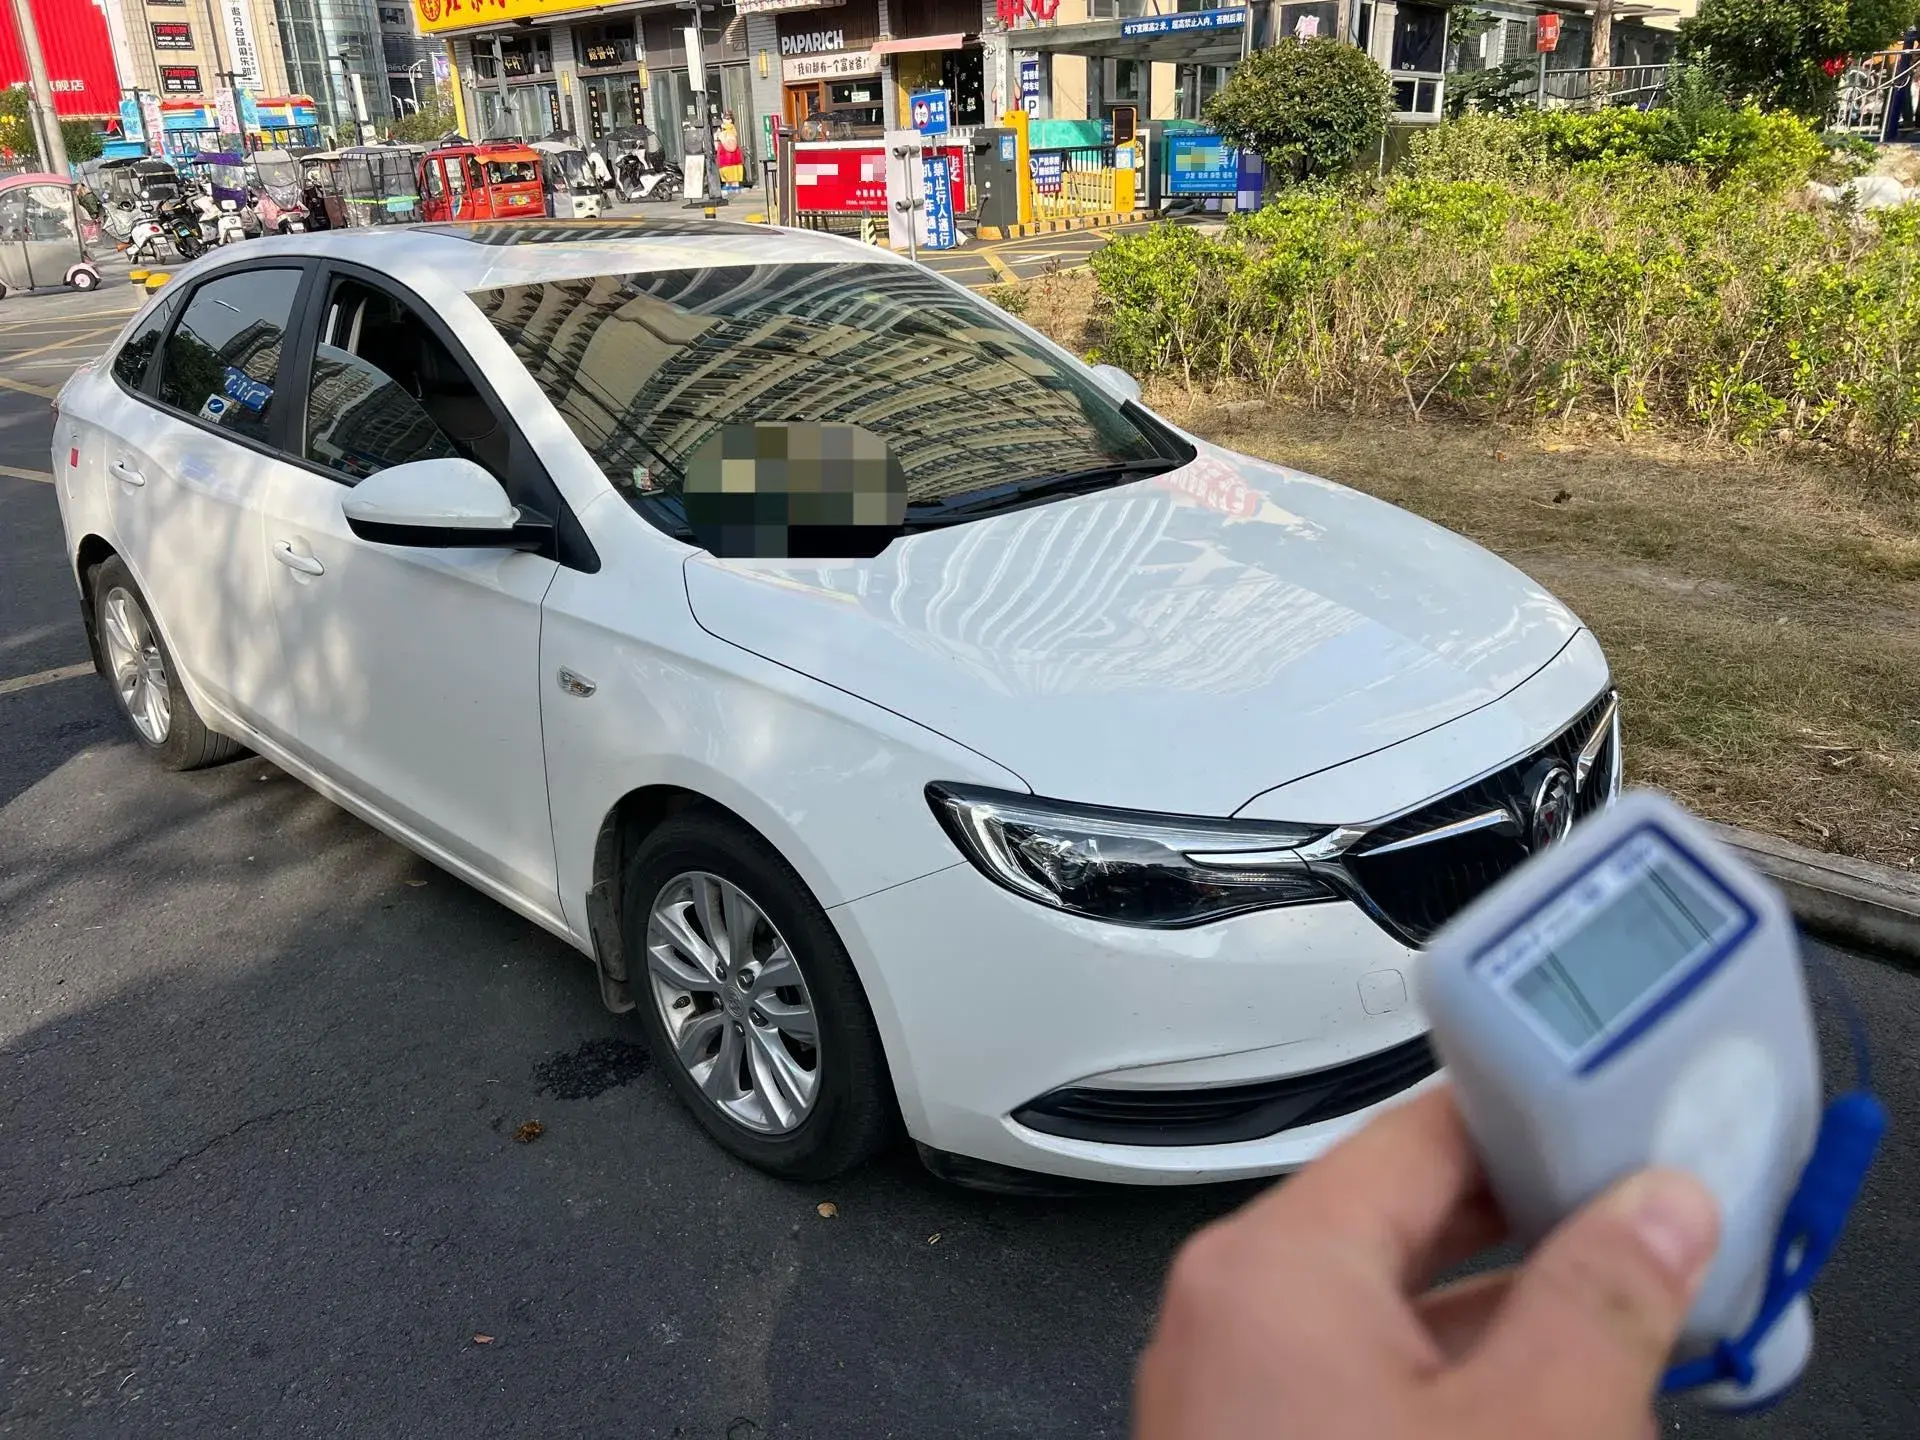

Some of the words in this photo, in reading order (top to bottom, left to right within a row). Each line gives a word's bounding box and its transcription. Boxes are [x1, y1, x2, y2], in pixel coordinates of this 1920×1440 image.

[1124, 13, 1245, 35] 地下室限高2米，超高禁止入内，否则后果
[781, 30, 844, 55] PAPARICH
[1028, 100, 1037, 116] P
[934, 162, 951, 245] 禁止行人通行
